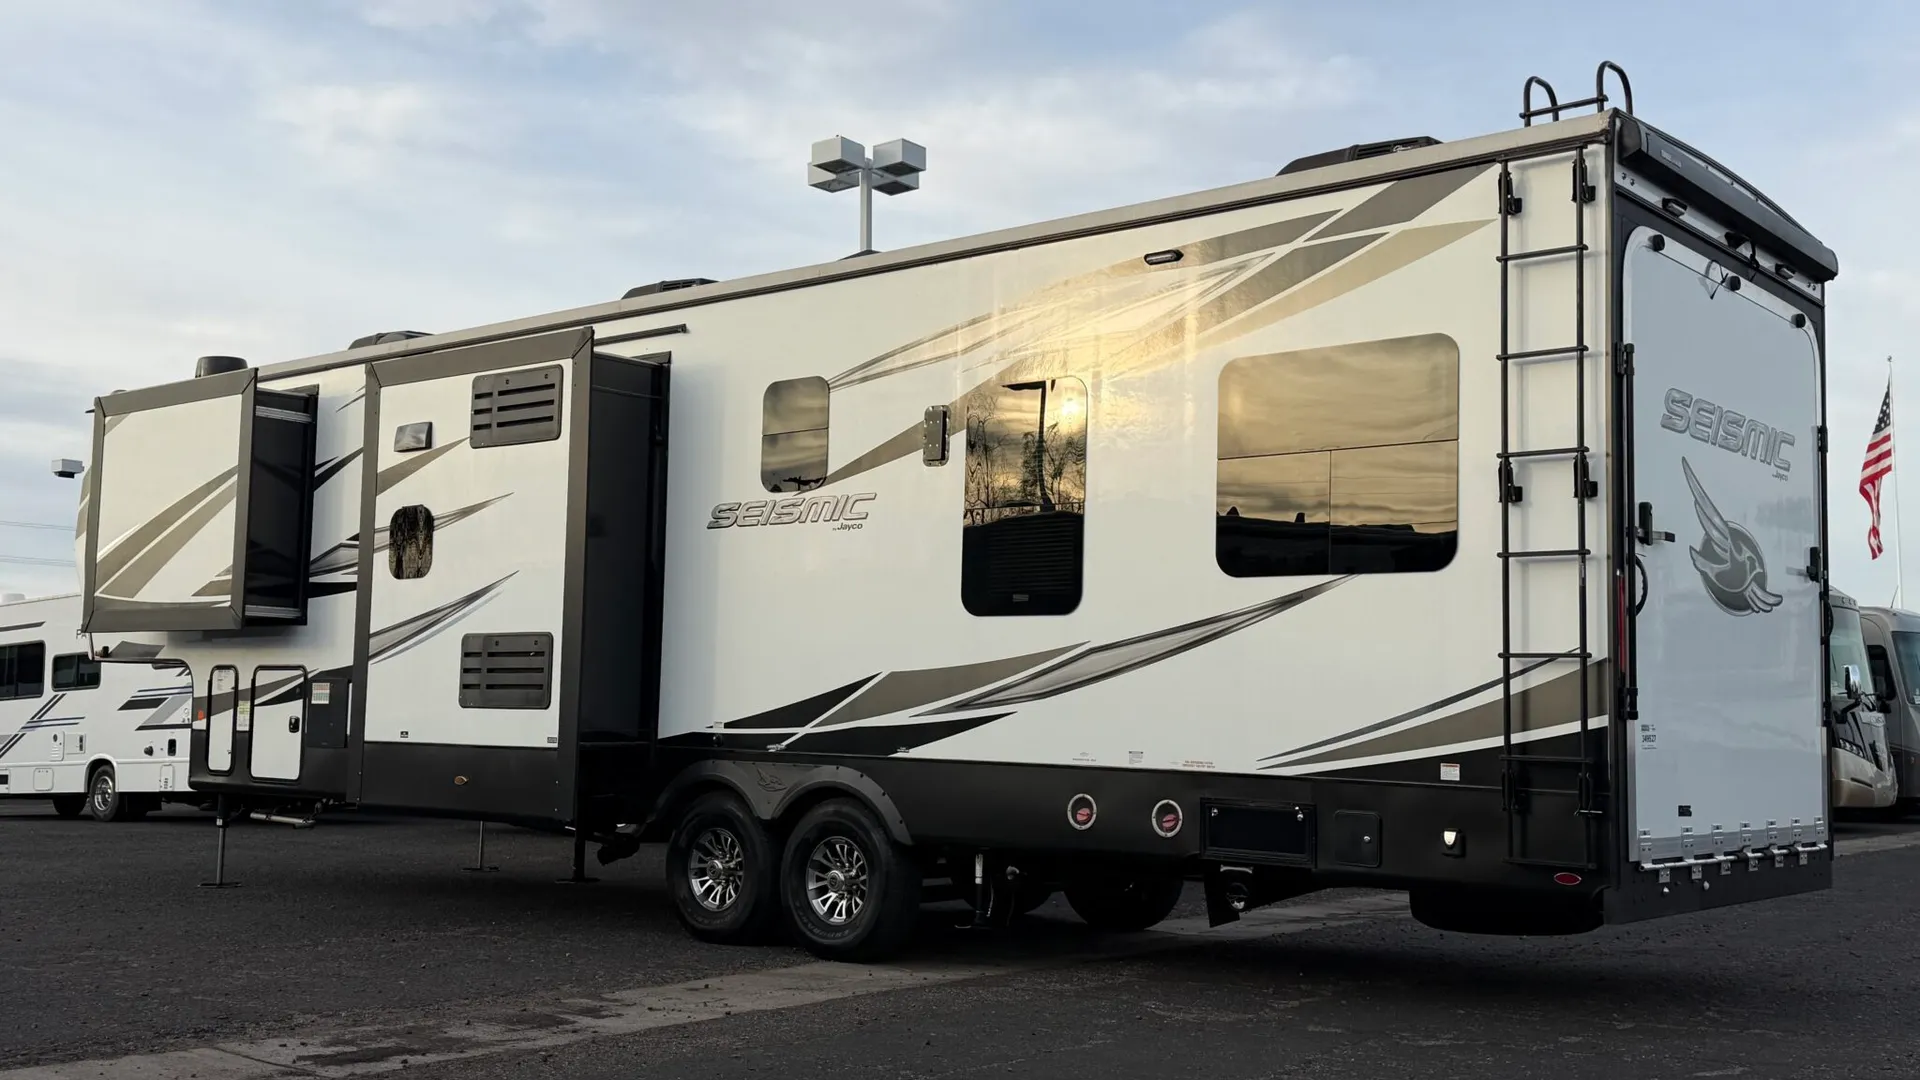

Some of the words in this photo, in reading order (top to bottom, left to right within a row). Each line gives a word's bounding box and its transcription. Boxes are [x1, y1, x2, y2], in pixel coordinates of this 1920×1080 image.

[1660, 387, 1796, 472] SEISMIC
[706, 492, 877, 529] SEISMIC
[837, 522, 863, 531] Jayco
